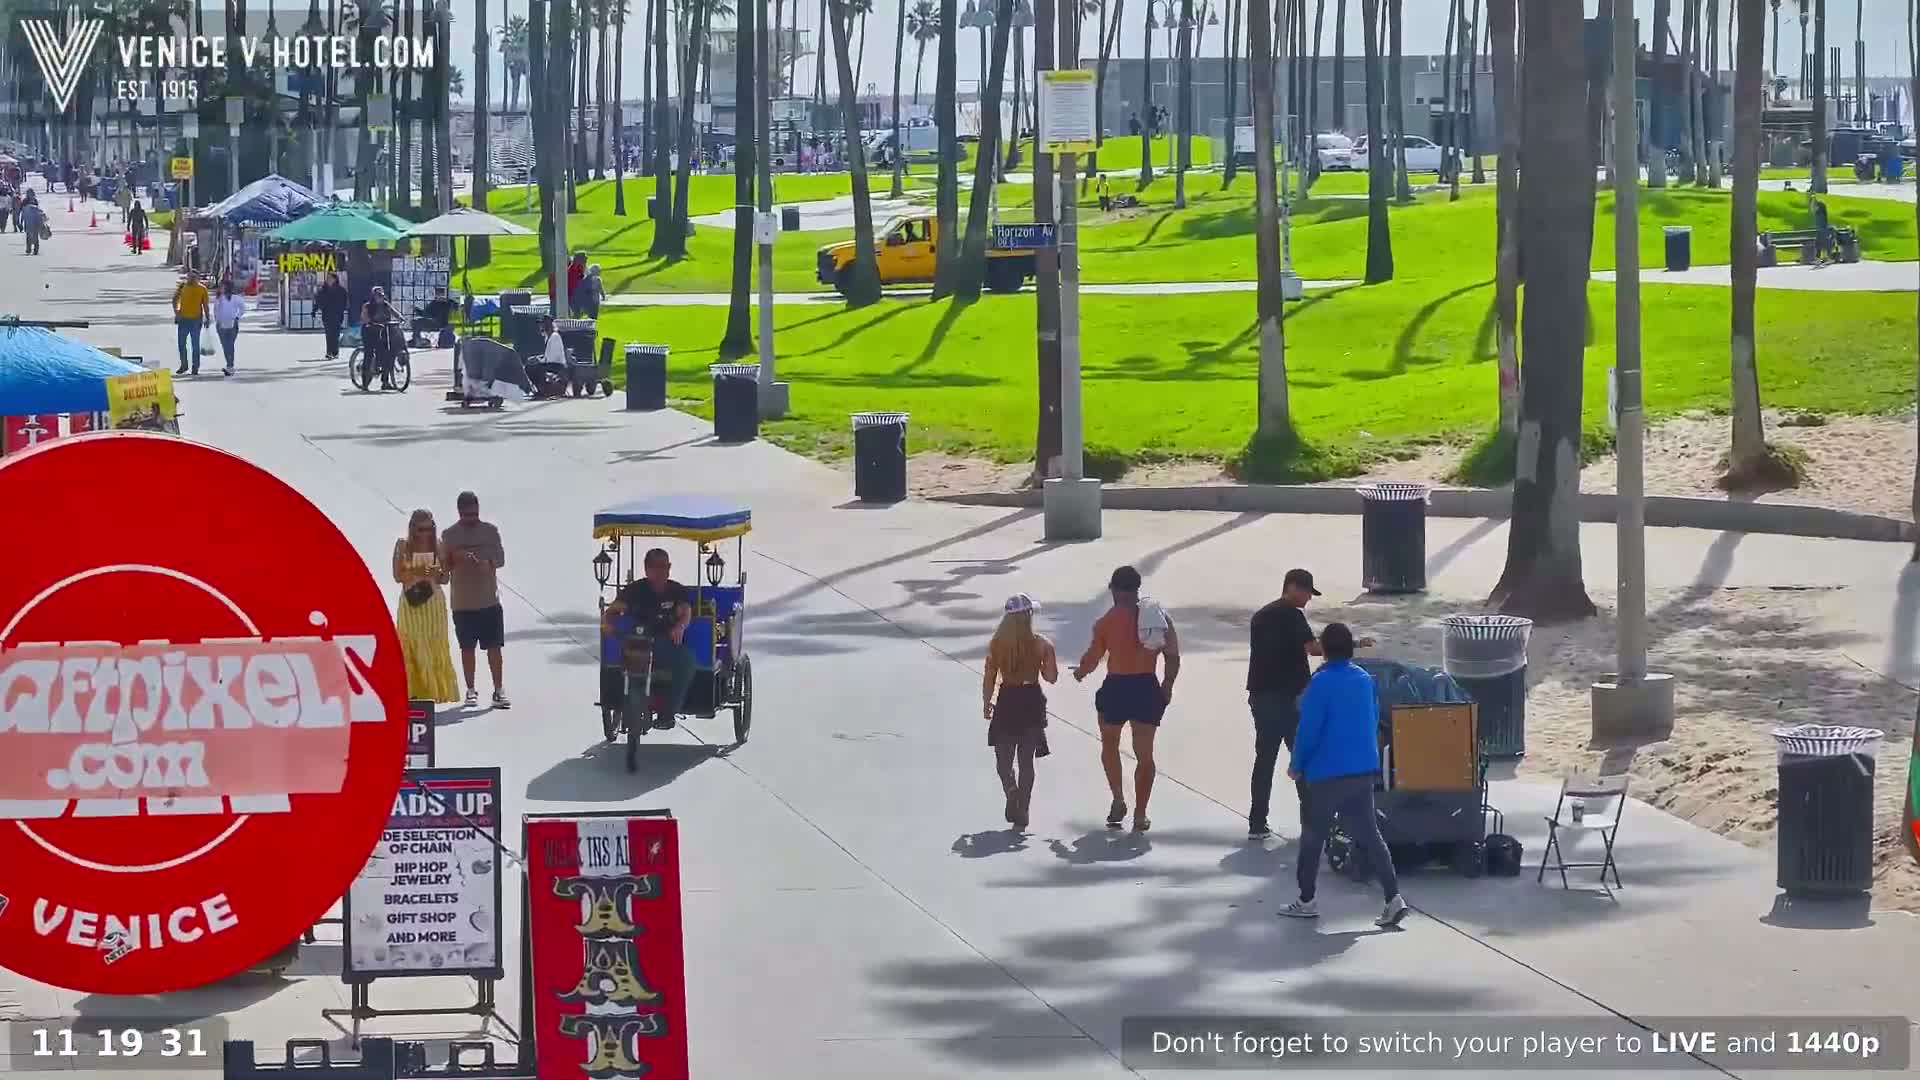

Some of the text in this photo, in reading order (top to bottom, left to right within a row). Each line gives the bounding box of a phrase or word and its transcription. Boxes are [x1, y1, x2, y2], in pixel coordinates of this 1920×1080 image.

[997, 225, 1035, 238] Horizon
[278, 252, 336, 273] HENNA
[408, 723, 427, 743] P
[390, 792, 493, 816] ADS UP
[379, 829, 476, 842] IDE SELECTION
[389, 842, 452, 854] OF CHAIN
[587, 835, 610, 867] INS
[395, 861, 448, 873] HIP HOP
[390, 873, 452, 886] JEWELRY
[384, 893, 459, 905] BRACELETS
[33, 893, 239, 951] VENICE
[387, 912, 456, 924] GIFT SHOP
[386, 931, 456, 943] AND MORE
